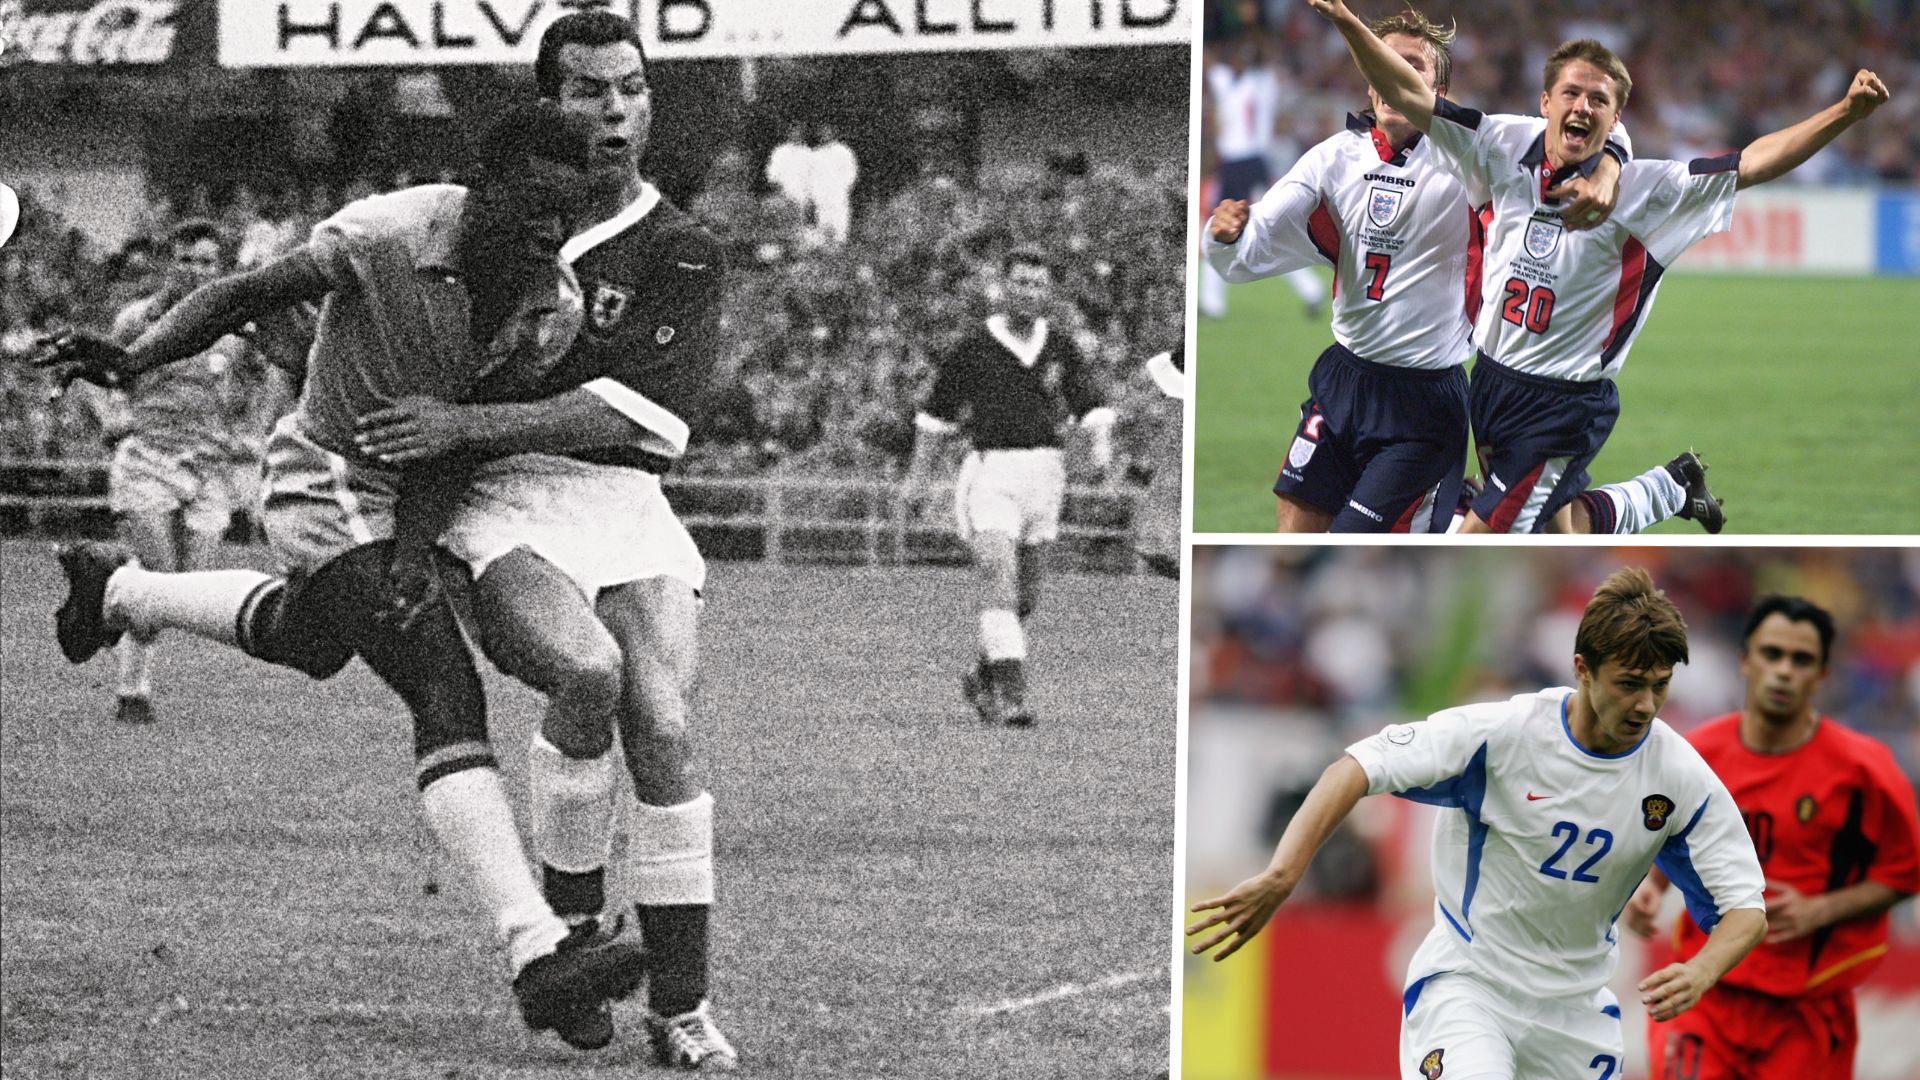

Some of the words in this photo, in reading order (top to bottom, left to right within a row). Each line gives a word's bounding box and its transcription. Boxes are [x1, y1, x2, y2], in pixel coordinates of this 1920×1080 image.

[1363, 173, 1416, 188] UMBRO
[1365, 227, 1396, 237] ENGLAND
[1369, 235, 1391, 244] WORLD
[1361, 239, 1384, 249] FRANCE
[1509, 261, 1522, 269] FIFA
[1523, 265, 1545, 277] WORLD
[1545, 272, 1559, 281] CUP
[1519, 257, 1551, 271] ENGLAND
[1365, 251, 1391, 302] 7
[1512, 268, 1537, 281] FRANCE
[1502, 275, 1556, 335] 20
[1349, 499, 1384, 523] UMBRO
[1539, 820, 1614, 884] 22
[1588, 1053, 1625, 1080] 2
